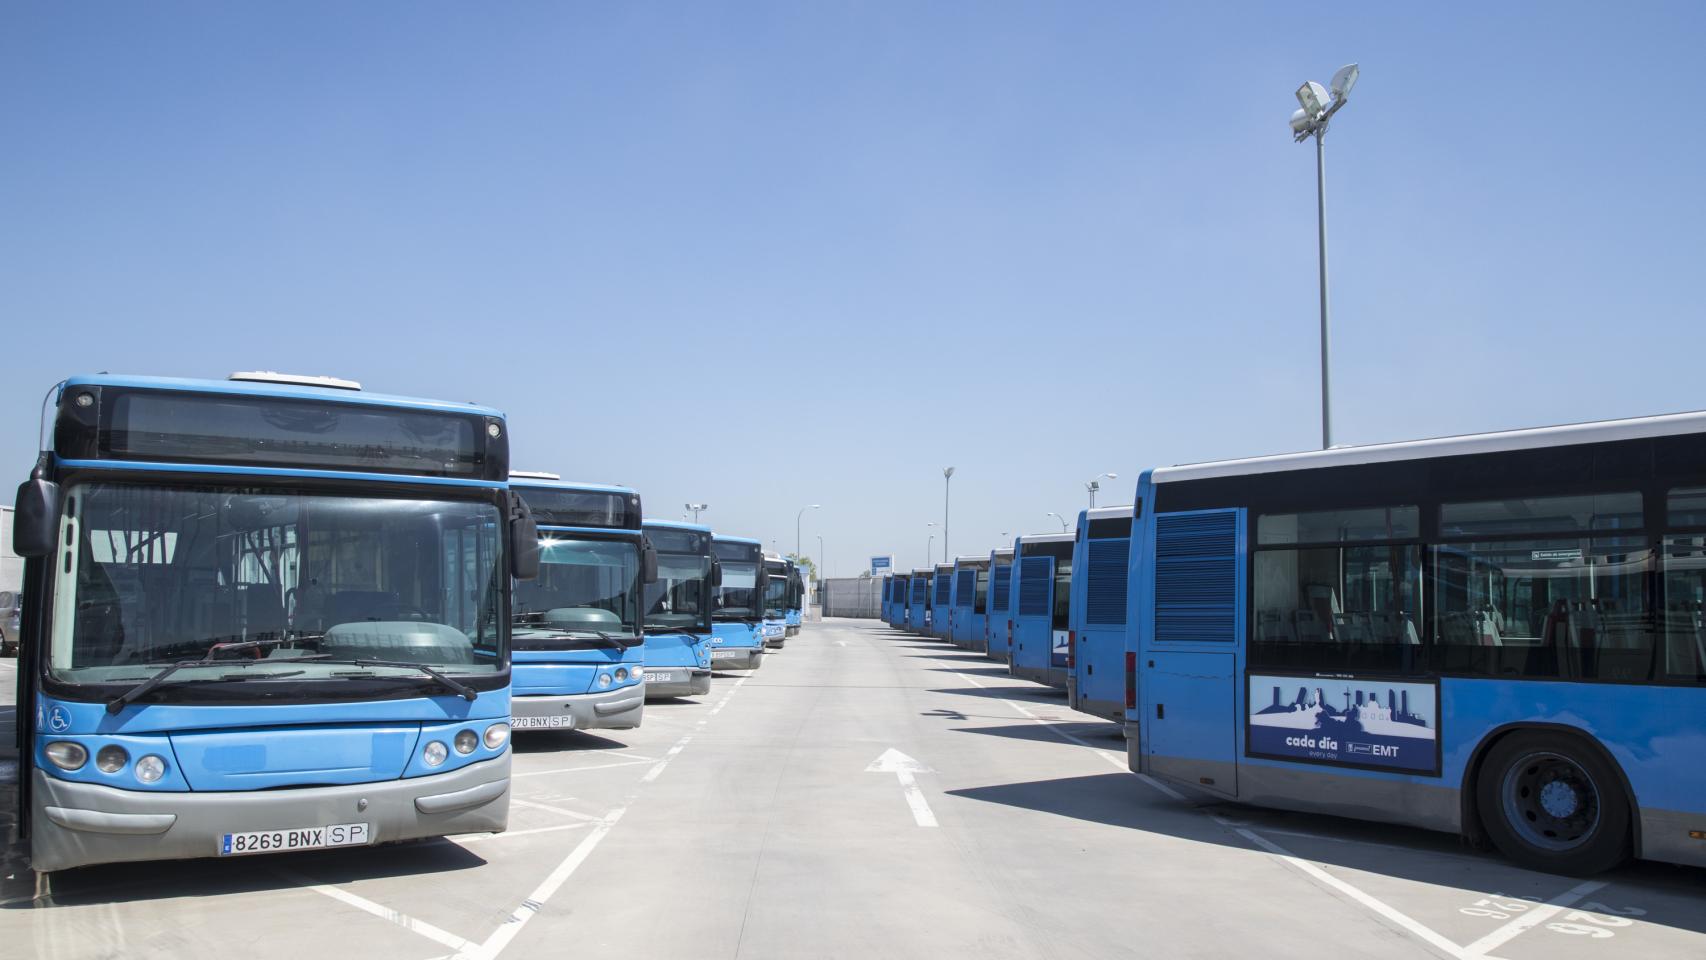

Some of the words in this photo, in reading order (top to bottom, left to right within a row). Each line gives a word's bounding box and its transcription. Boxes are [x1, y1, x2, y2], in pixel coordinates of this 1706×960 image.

[530, 717, 548, 727] BNX
[1286, 735, 1316, 748] cada
[1318, 736, 1338, 751] día
[1309, 750, 1325, 759] every
[1327, 752, 1338, 760] day
[1372, 744, 1399, 757] EMT
[235, 833, 283, 851] 8269
[288, 830, 322, 847] BNX
